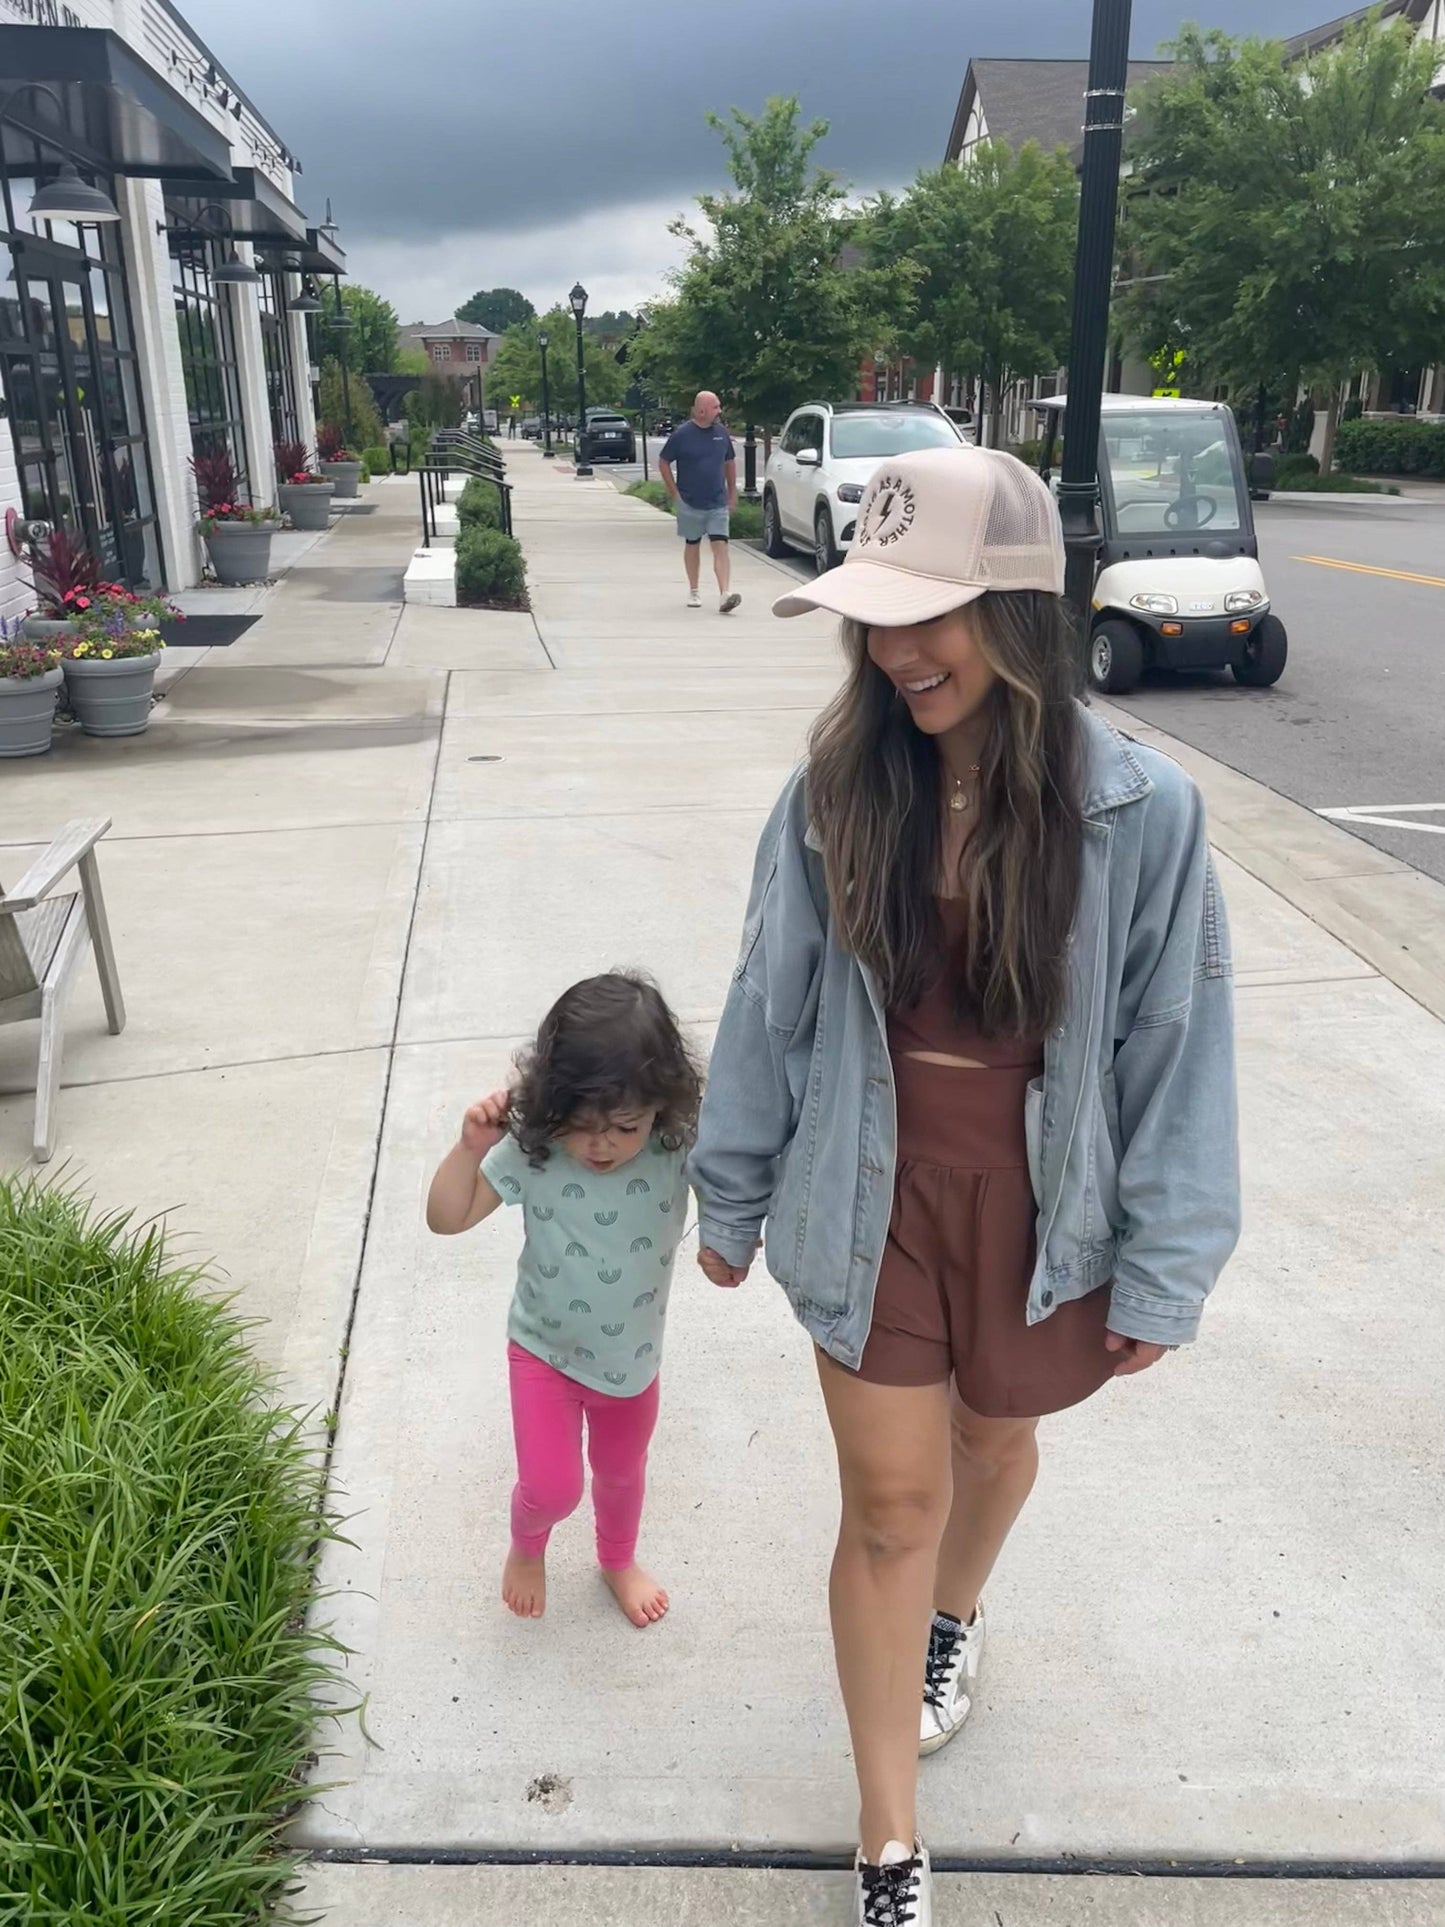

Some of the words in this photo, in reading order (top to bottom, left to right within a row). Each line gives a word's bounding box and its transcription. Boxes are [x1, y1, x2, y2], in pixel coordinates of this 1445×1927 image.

[879, 476, 892, 493] AS
[892, 478, 903, 493] A
[879, 487, 915, 547] MOTHER
